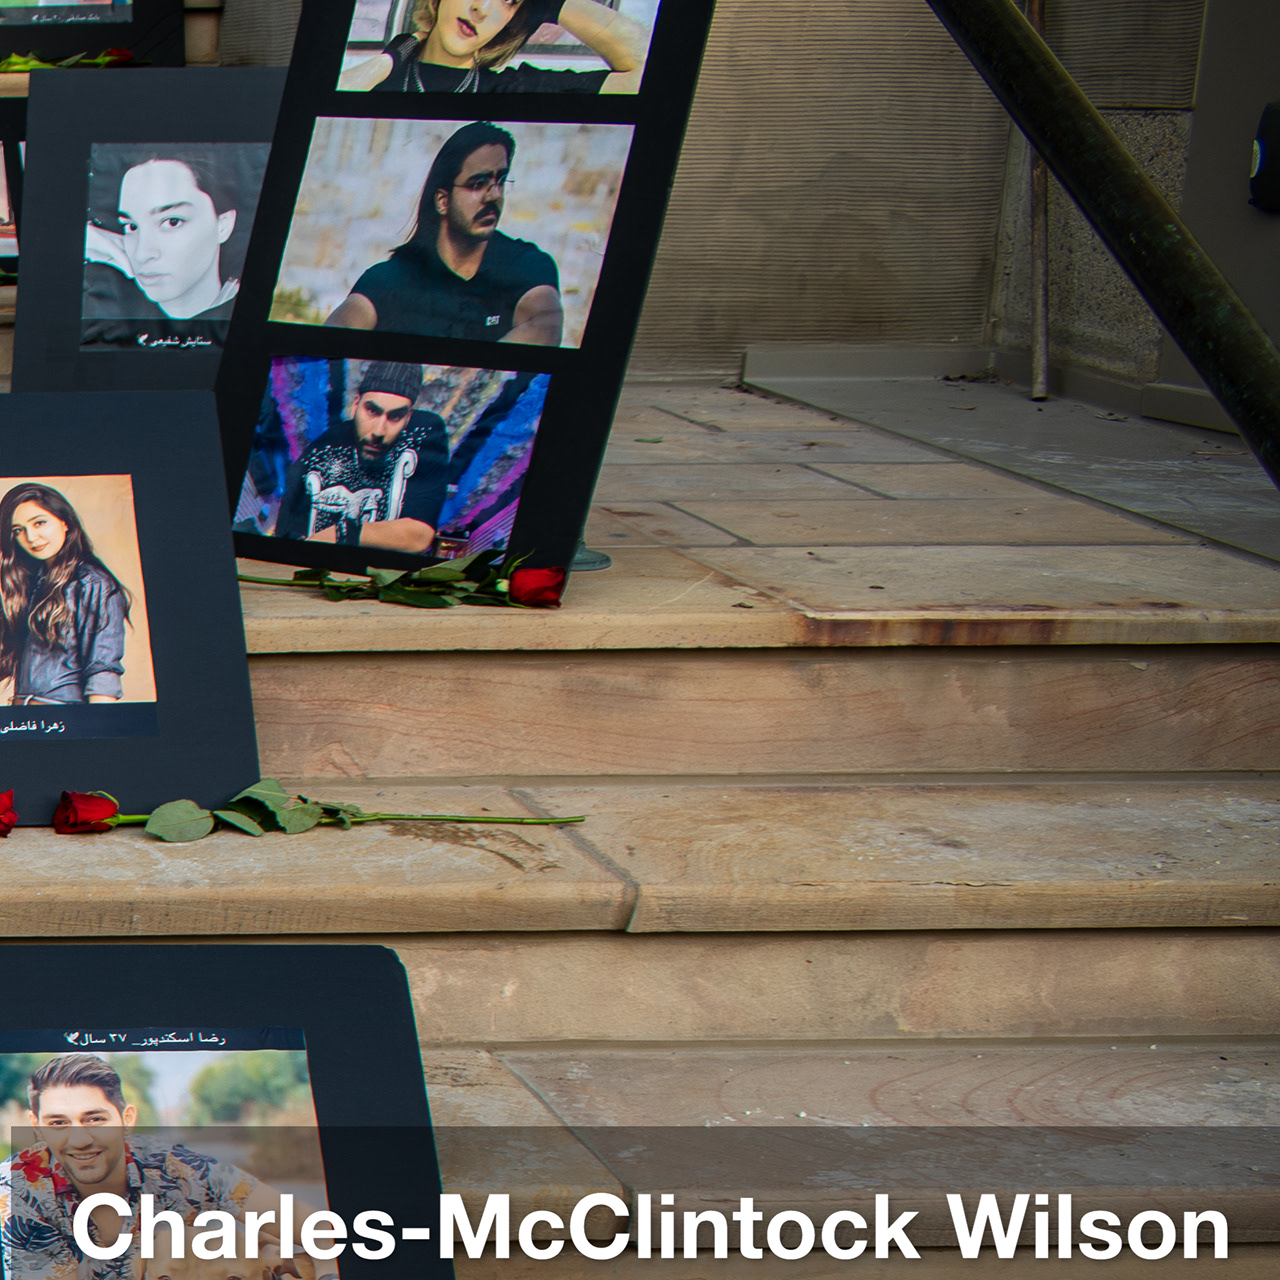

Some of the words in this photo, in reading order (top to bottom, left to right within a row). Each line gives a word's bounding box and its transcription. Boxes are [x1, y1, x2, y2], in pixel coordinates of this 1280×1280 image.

[148, 336, 180, 348] شفیعی
[180, 336, 212, 349] ستایش
[0, 719, 38, 735] فاضلی
[40, 719, 66, 734] زهرا
[79, 1032, 107, 1047] سال
[198, 1031, 227, 1046] رضا
